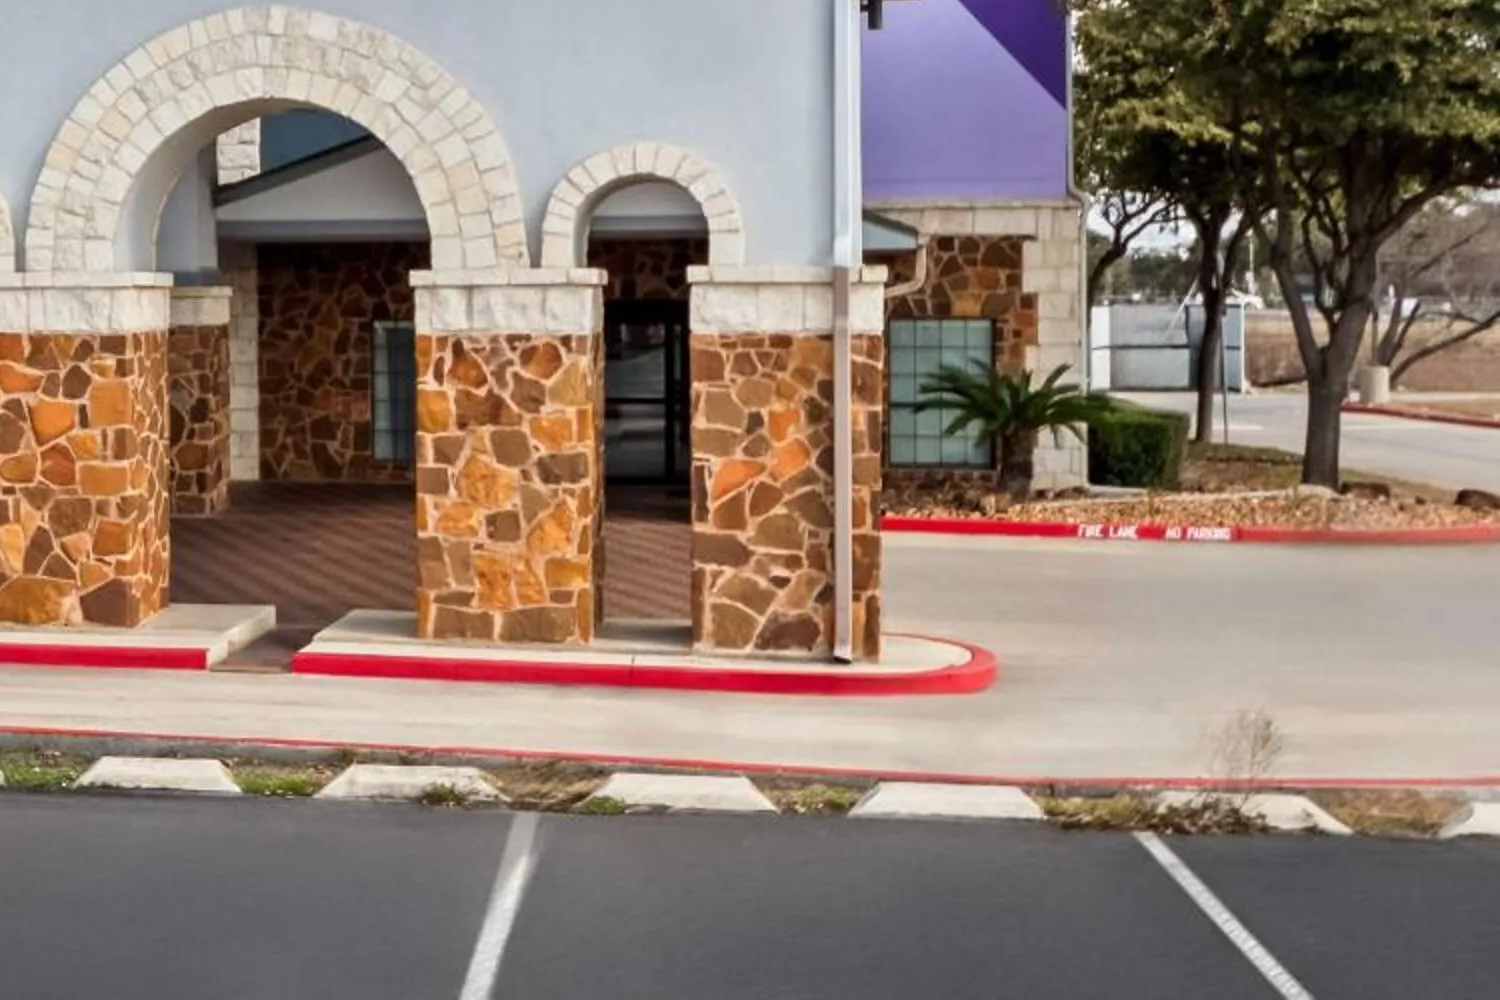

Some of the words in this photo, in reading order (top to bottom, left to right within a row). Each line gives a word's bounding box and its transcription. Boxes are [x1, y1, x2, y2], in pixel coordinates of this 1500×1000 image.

[1077, 525, 1104, 538] FIRE
[1109, 525, 1139, 539] LANE
[1164, 527, 1182, 540] NO
[1186, 527, 1232, 540] PARKING
